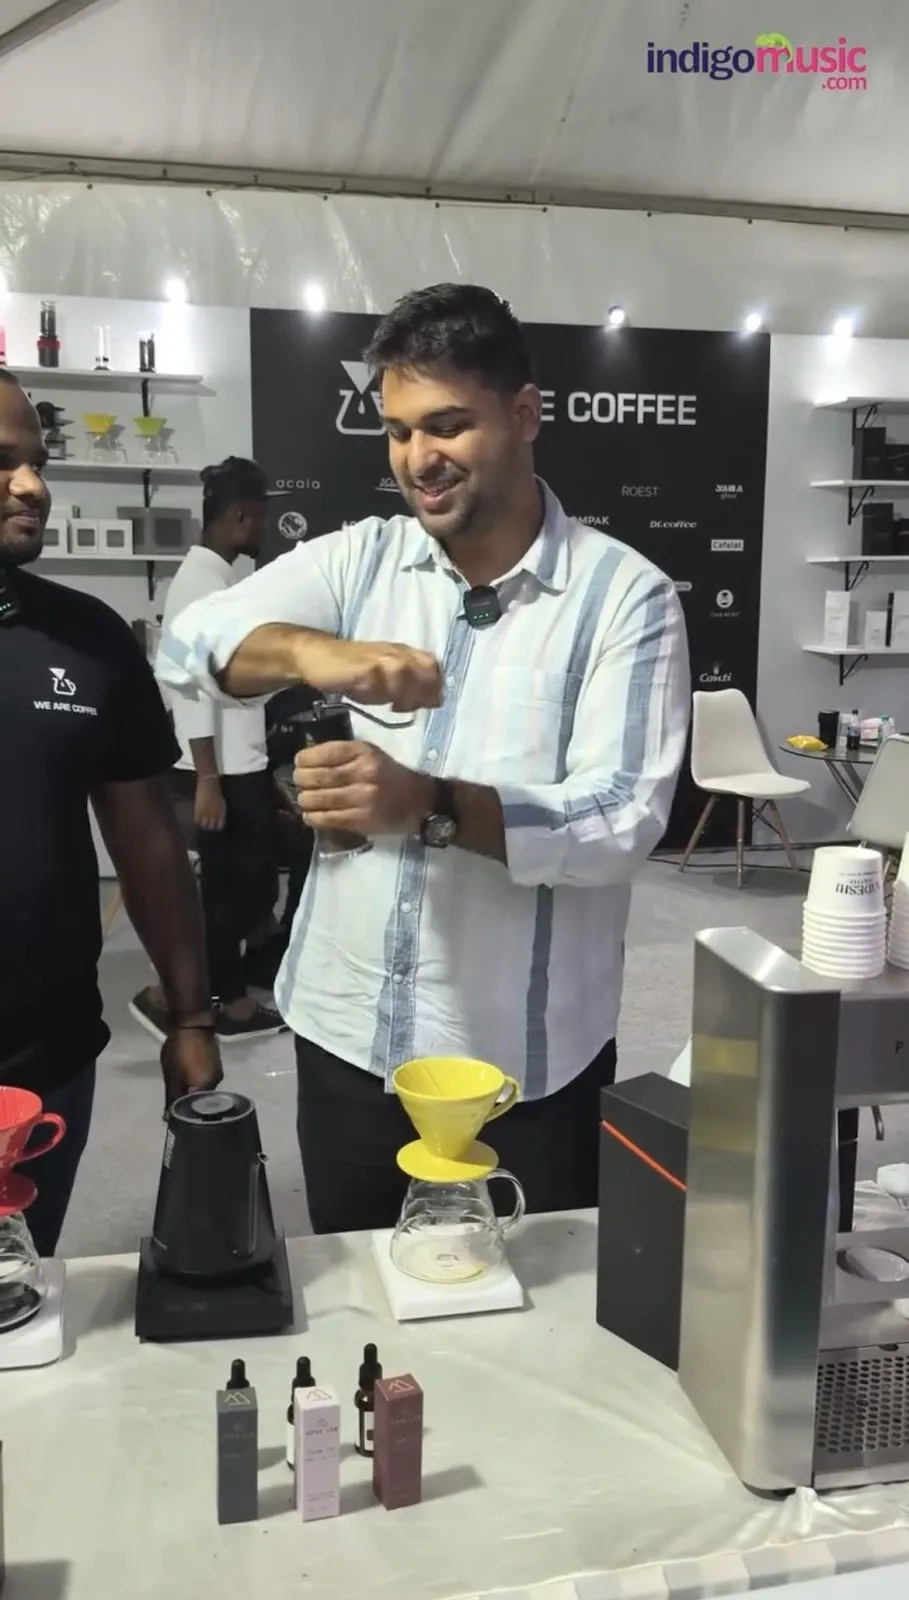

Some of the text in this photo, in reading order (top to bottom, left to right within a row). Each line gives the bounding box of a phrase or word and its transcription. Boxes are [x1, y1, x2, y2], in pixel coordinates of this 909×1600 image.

[568, 391, 697, 426] COFFEE
[621, 485, 659, 498] ROEST
[33, 700, 98, 716] WE ARE COFFEE
[894, 1040, 905, 1054] P
